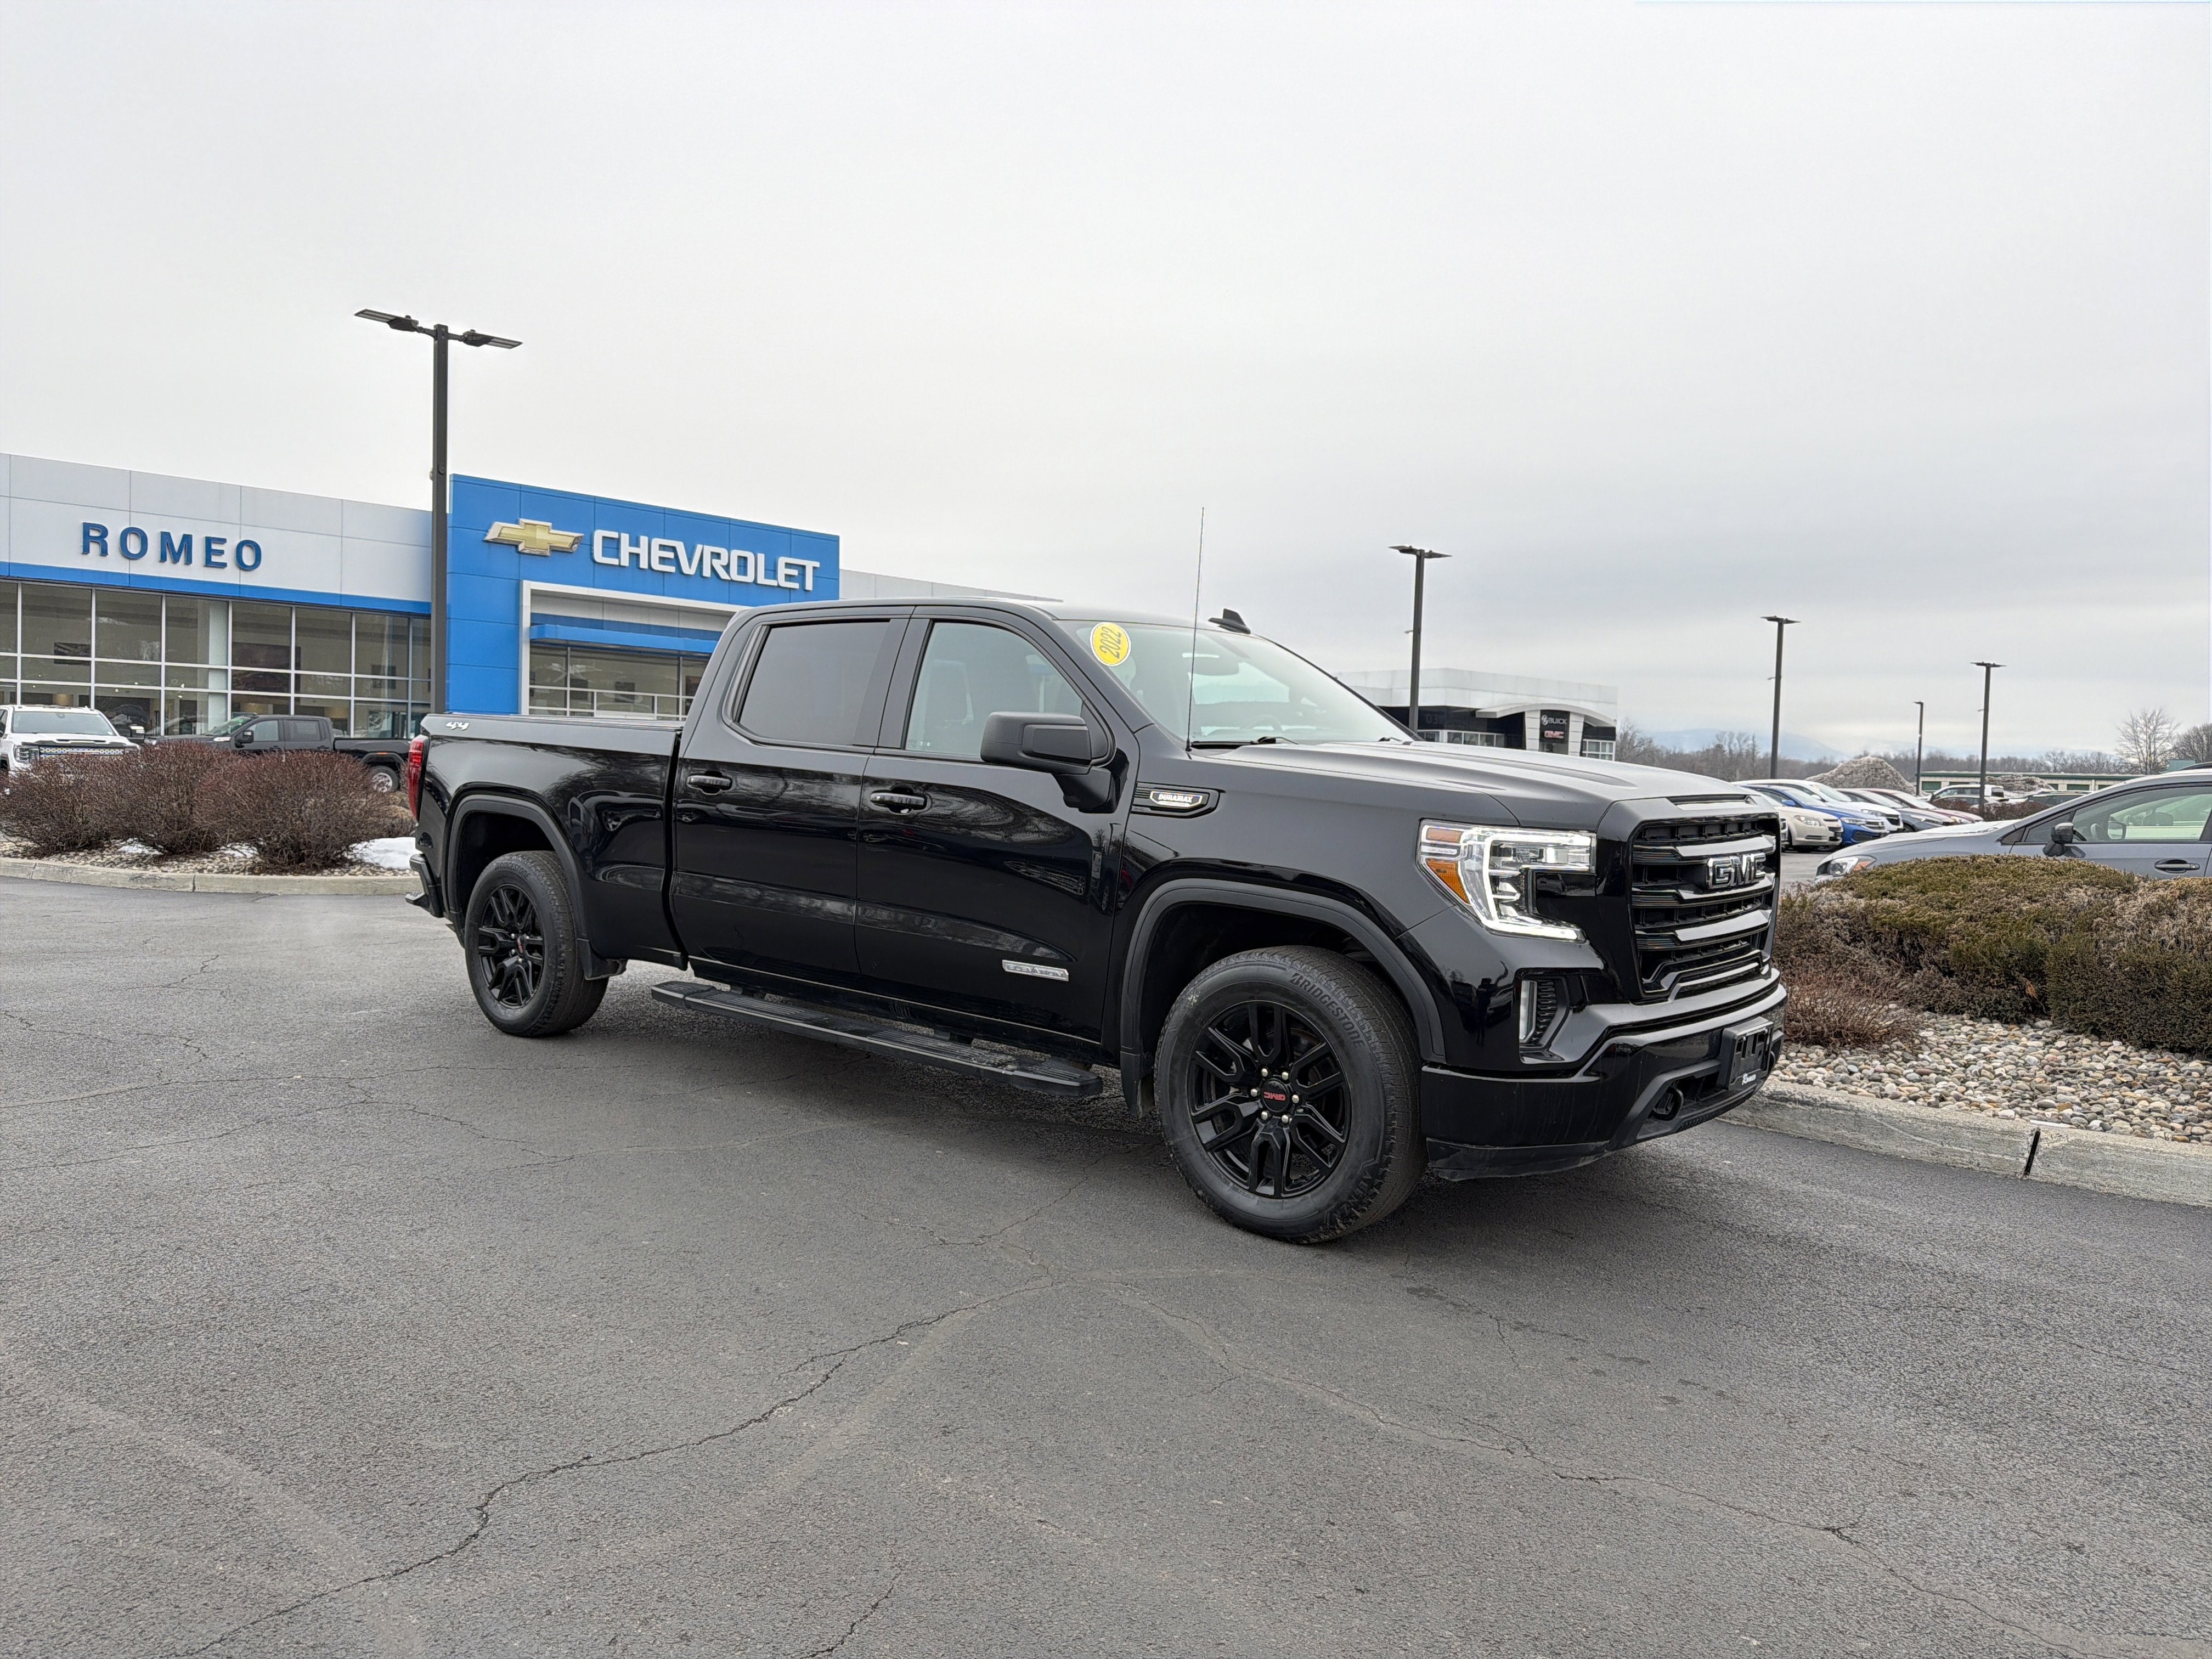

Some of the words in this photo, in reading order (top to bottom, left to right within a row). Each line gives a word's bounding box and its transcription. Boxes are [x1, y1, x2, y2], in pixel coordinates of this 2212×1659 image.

[81, 522, 262, 572] ROMEO
[593, 529, 821, 591] CHEVROLET
[1099, 626, 1122, 659] 2022
[1544, 730, 1564, 739] GMC
[1158, 793, 1194, 803] DURAMAX
[1706, 852, 1767, 889] GMC
[1289, 972, 1366, 1048] BRIDGESTONE
[1263, 1091, 1286, 1102] GMC
